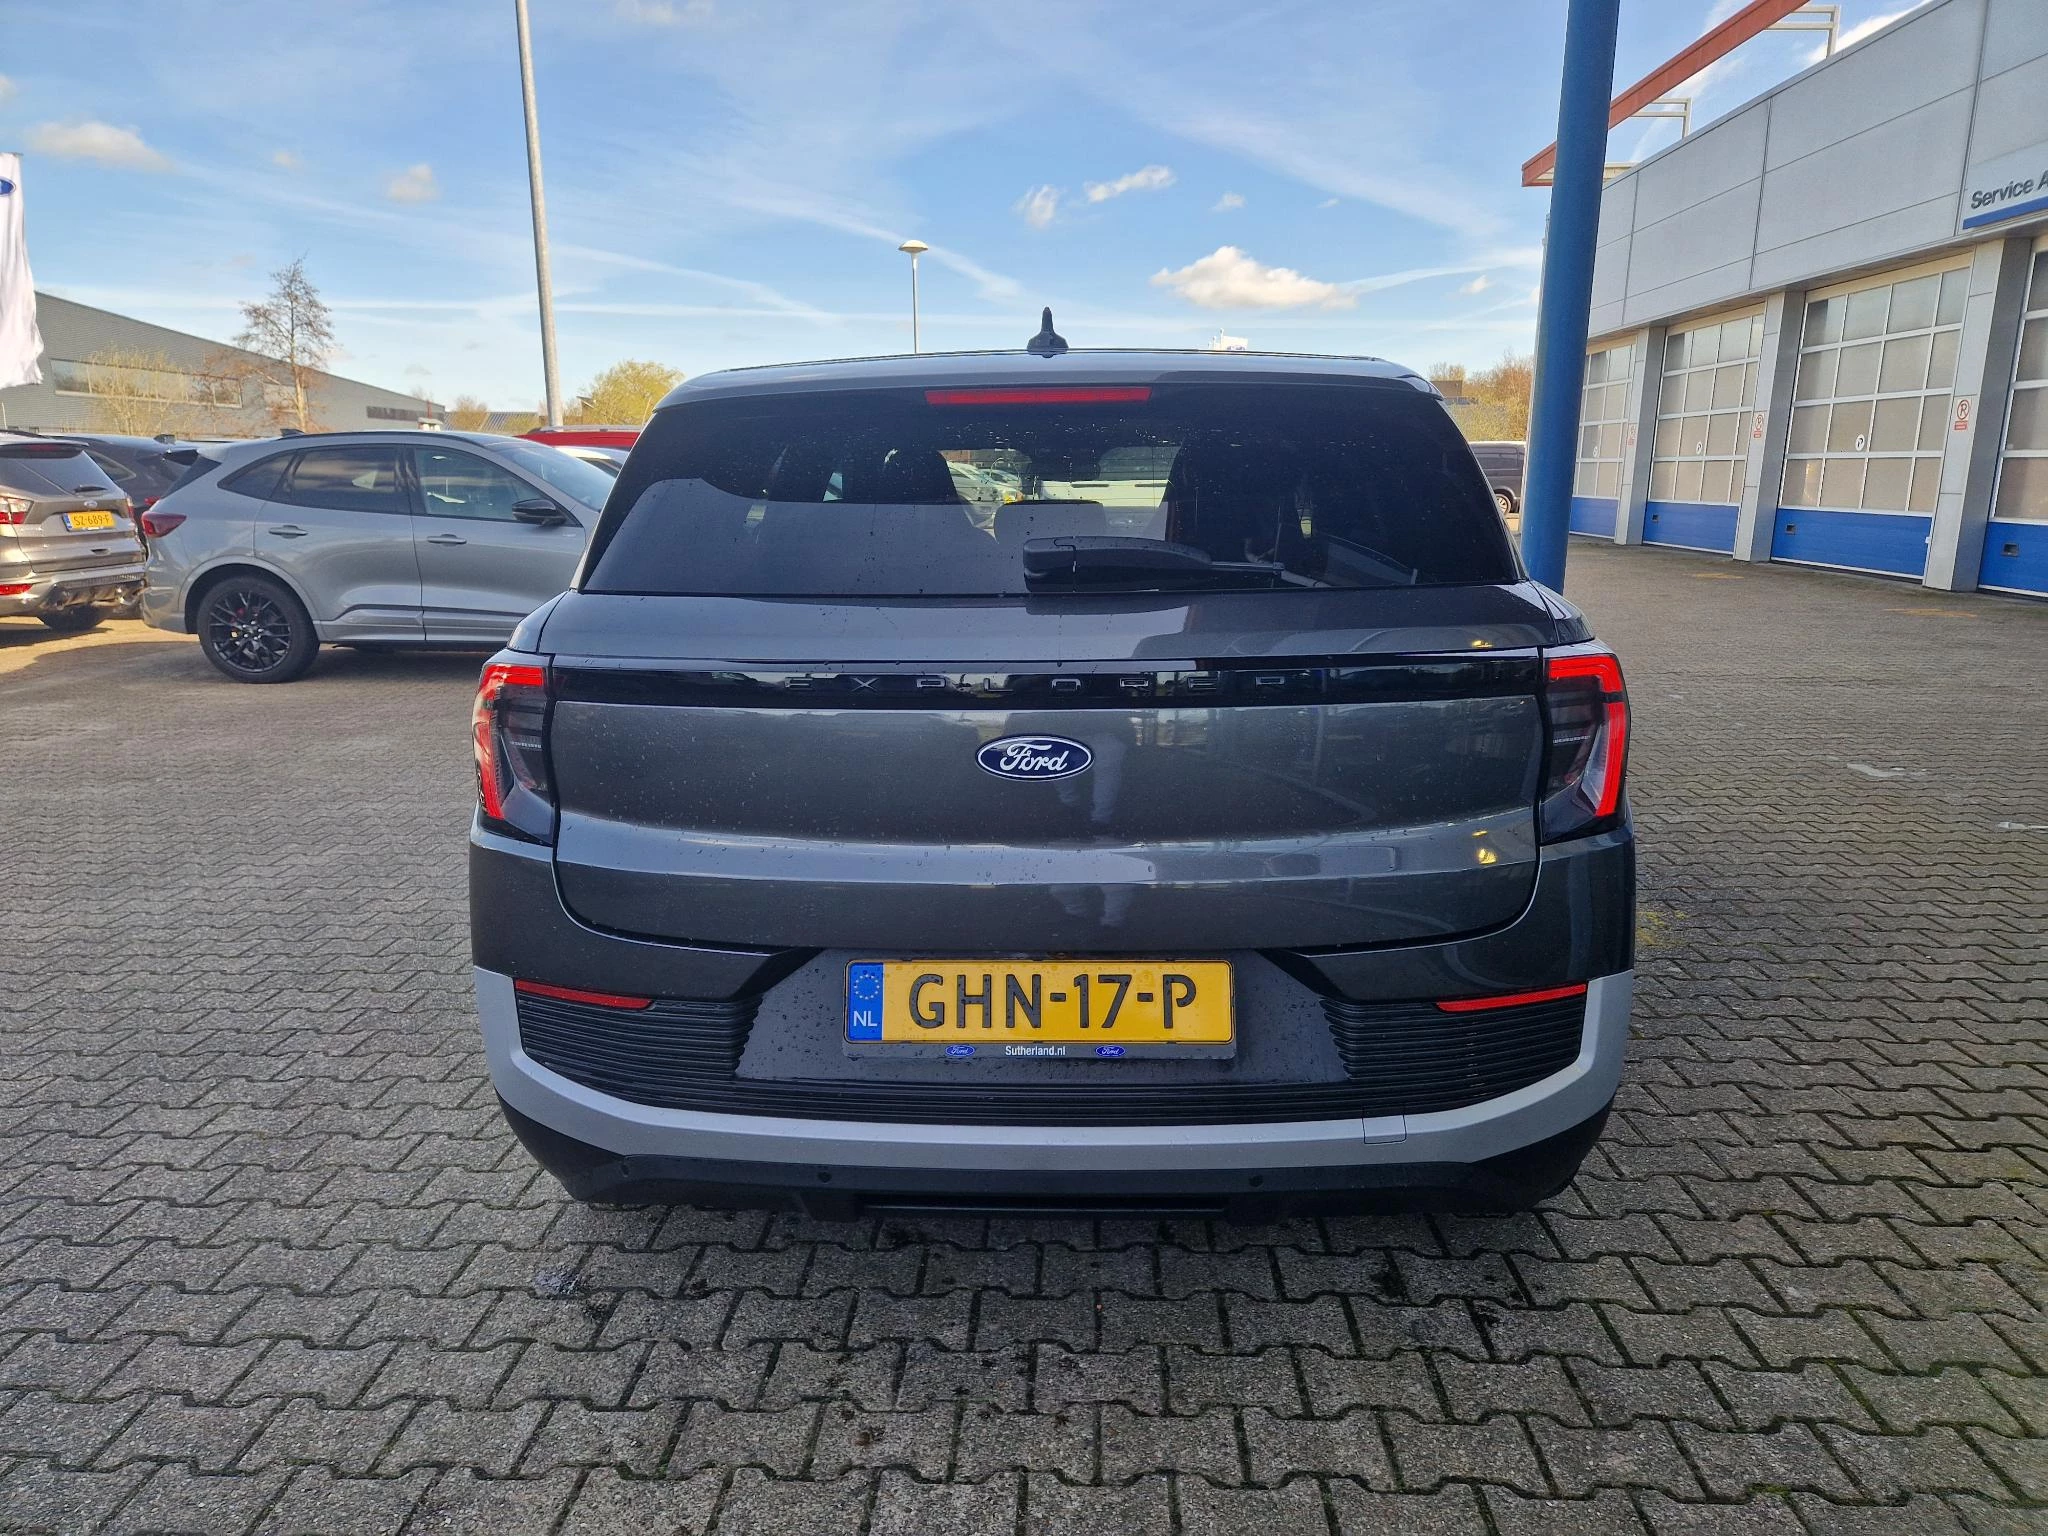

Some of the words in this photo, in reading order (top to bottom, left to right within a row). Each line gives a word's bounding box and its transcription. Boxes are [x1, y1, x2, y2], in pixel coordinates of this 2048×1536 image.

[1971, 179, 2034, 209] Service
[1000, 743, 1069, 771] Ford
[908, 973, 1197, 1029] GHN-17-P
[853, 1010, 878, 1027] NL
[1005, 1045, 1066, 1056] Sutherland.nl
